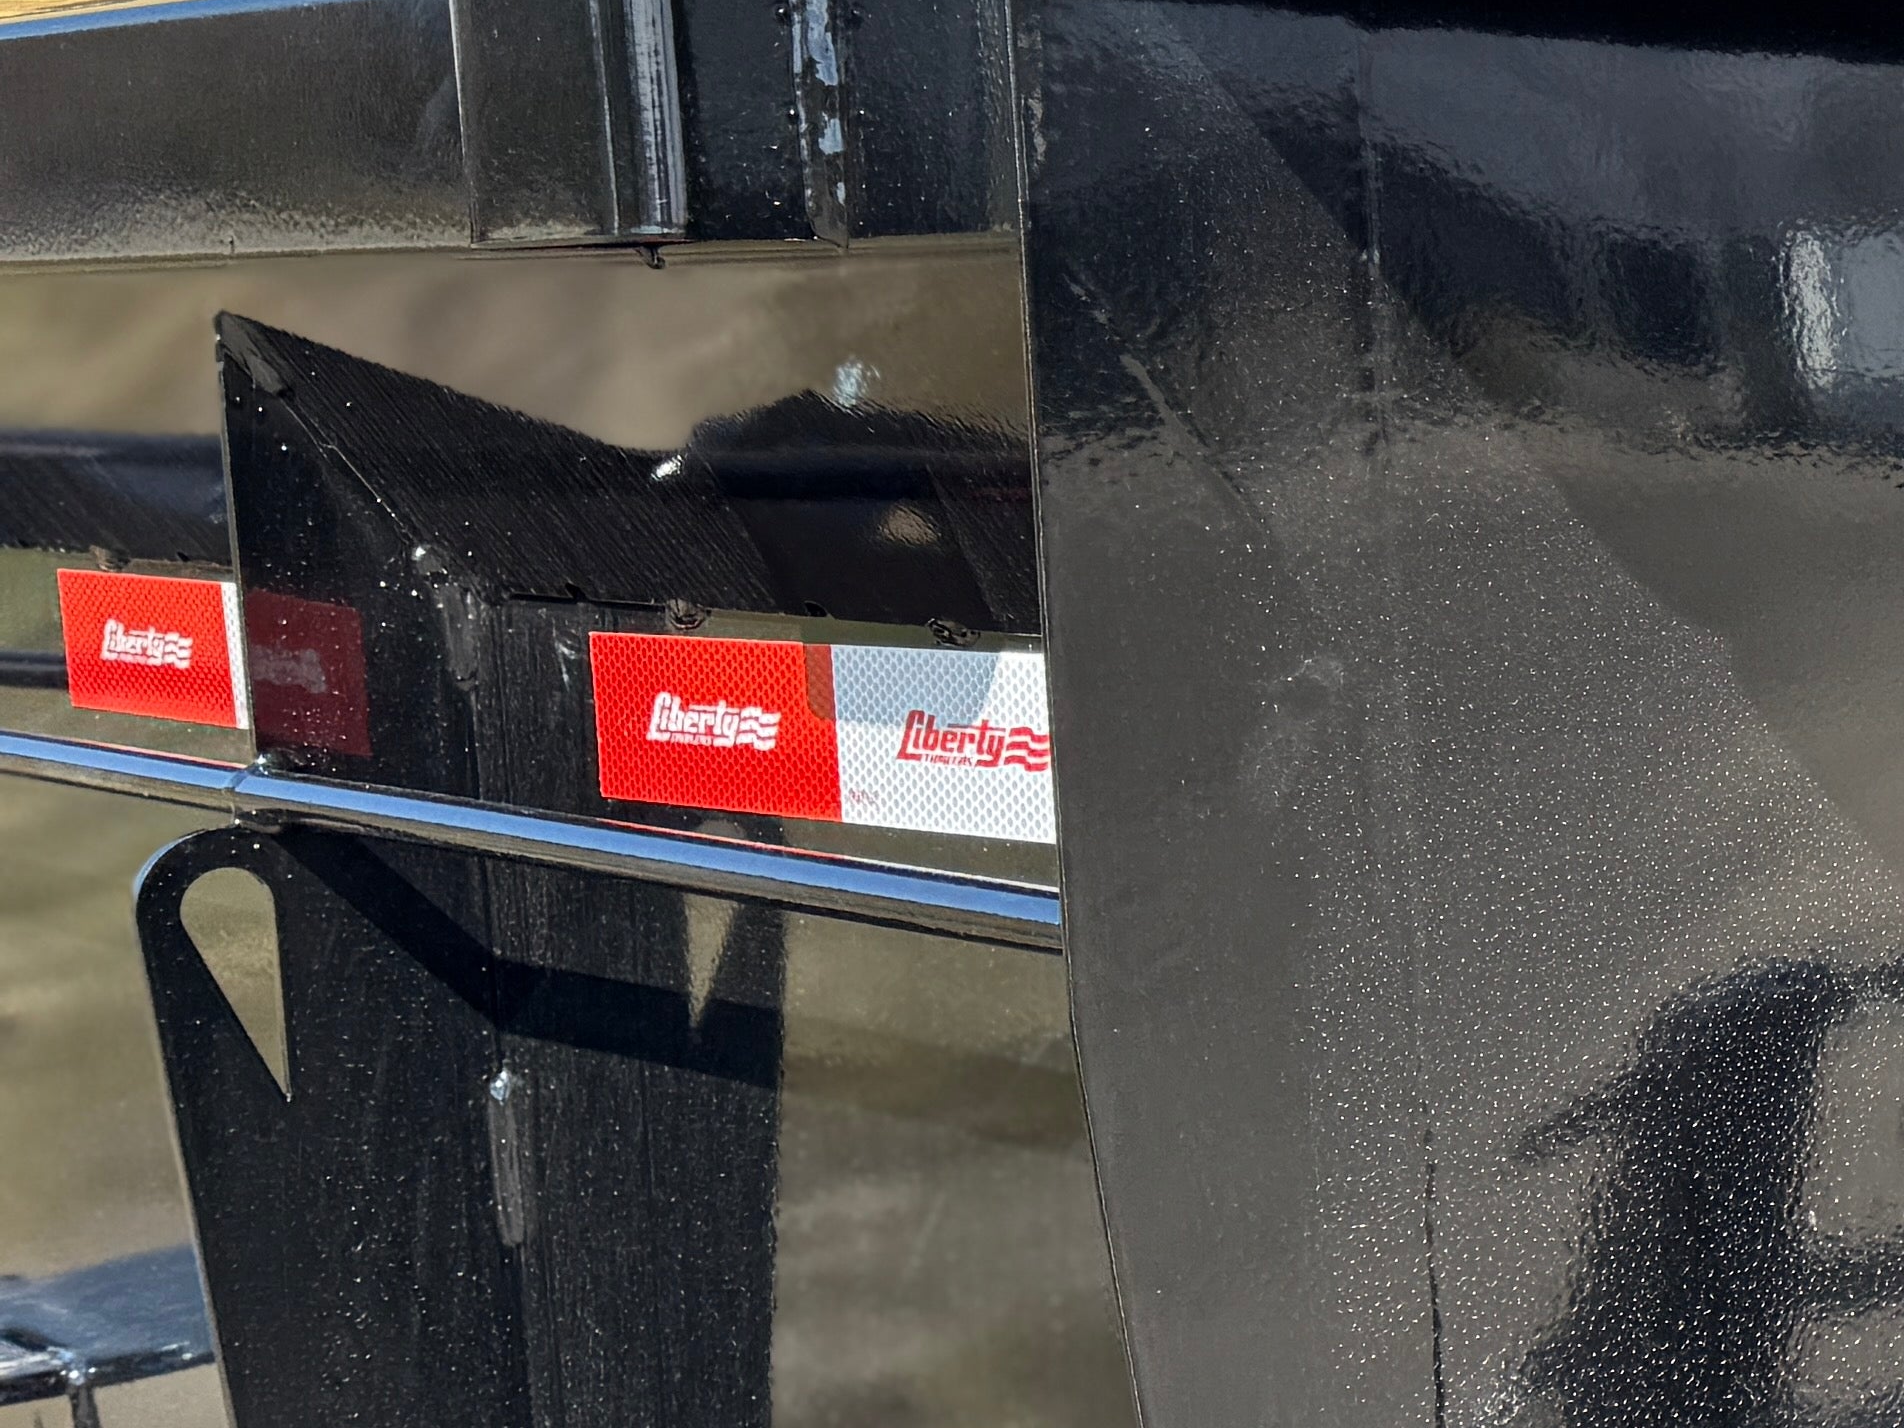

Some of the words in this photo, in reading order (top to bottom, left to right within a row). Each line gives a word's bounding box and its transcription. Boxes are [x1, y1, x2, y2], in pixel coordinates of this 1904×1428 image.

[101, 619, 165, 667] Liberty
[646, 691, 741, 748] Liberty
[896, 709, 1006, 768] Liberty
